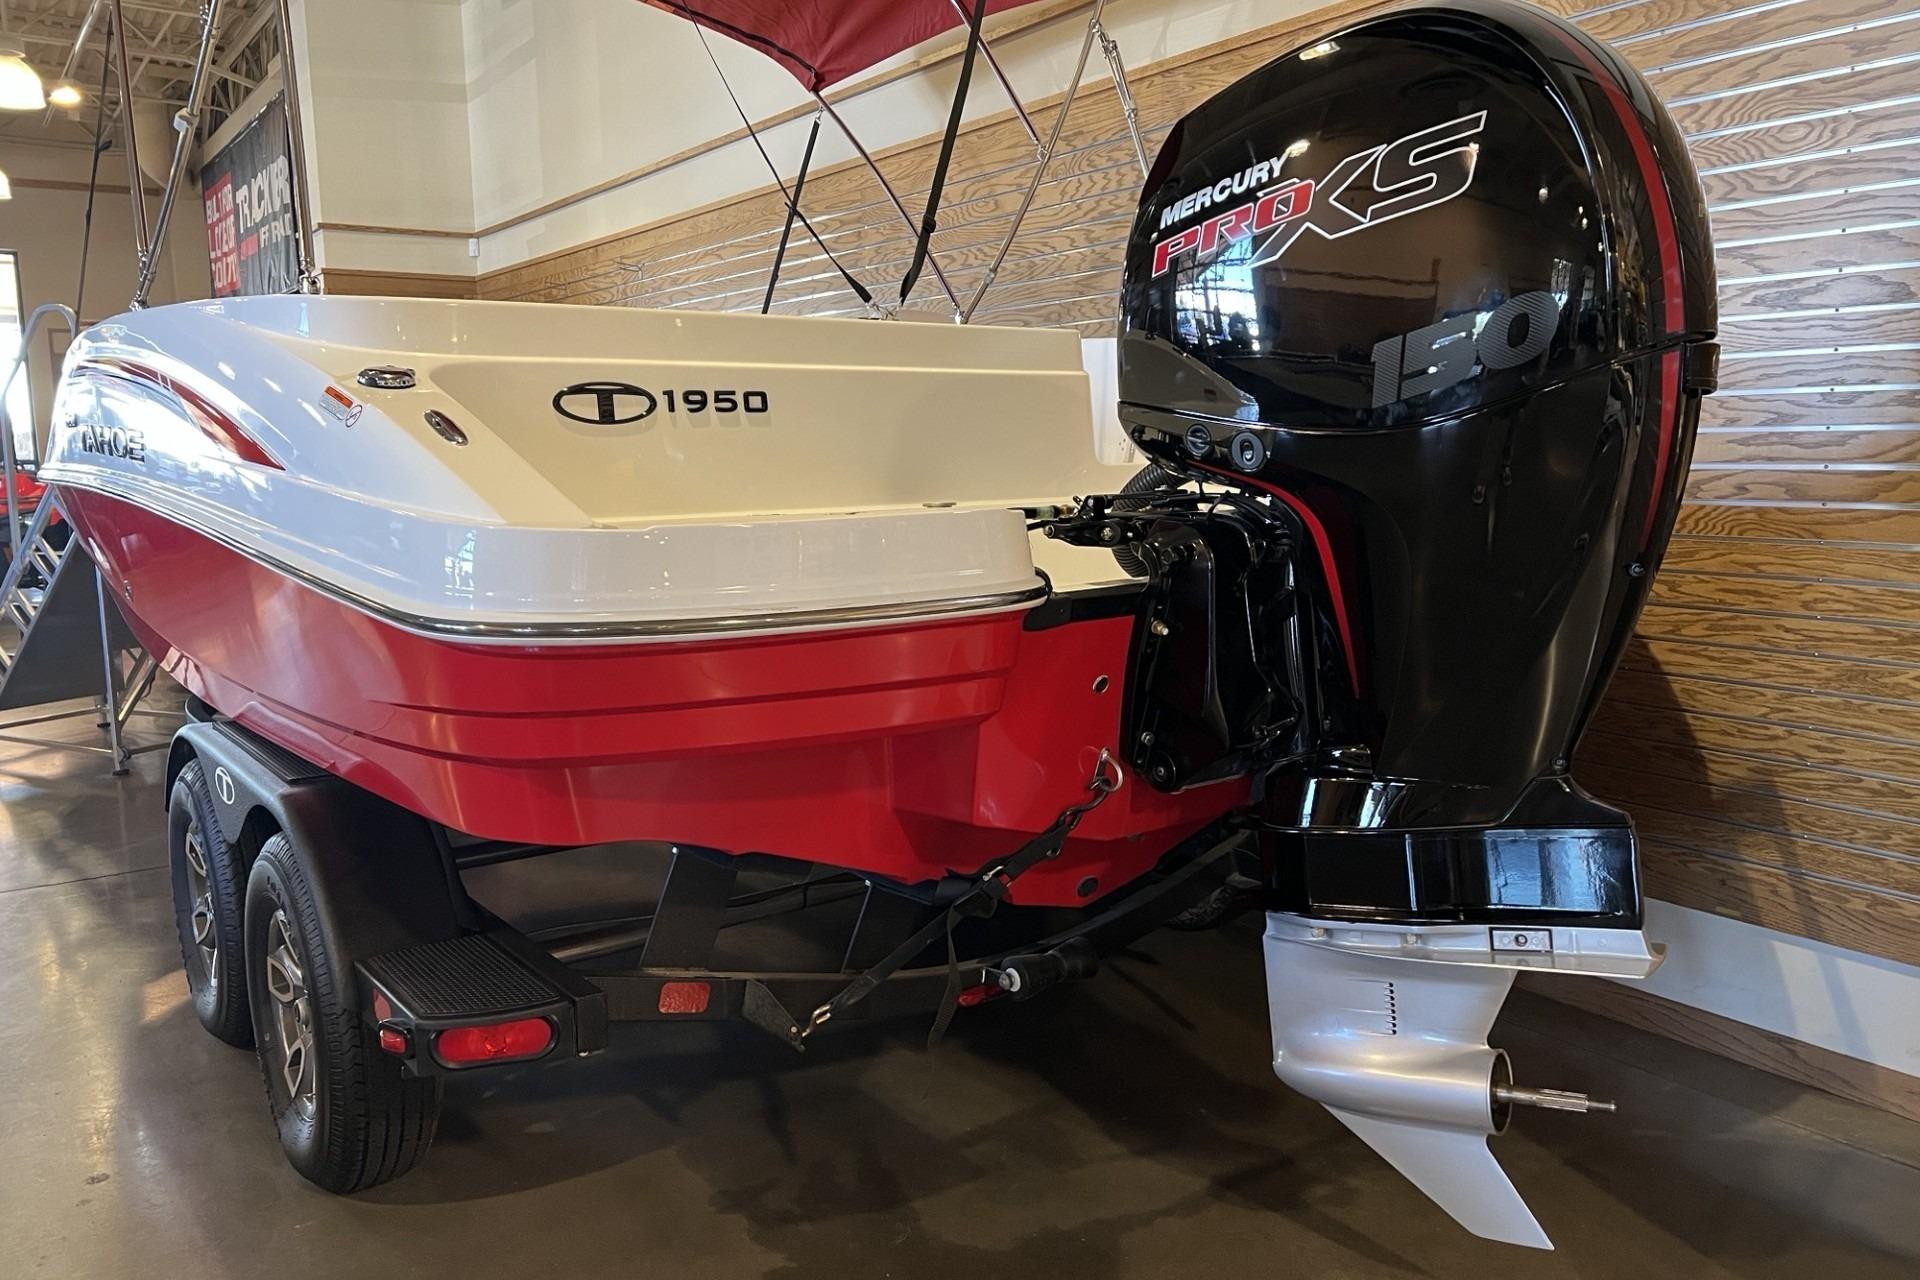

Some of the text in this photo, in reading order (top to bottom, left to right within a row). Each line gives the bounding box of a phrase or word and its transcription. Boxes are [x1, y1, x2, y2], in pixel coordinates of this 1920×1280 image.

[236, 154, 291, 234] TRACKER
[1160, 150, 1289, 230] MERCURY
[1370, 290, 1561, 410] 150
[662, 389, 769, 414] 1950
[78, 425, 146, 464] TAHOE
